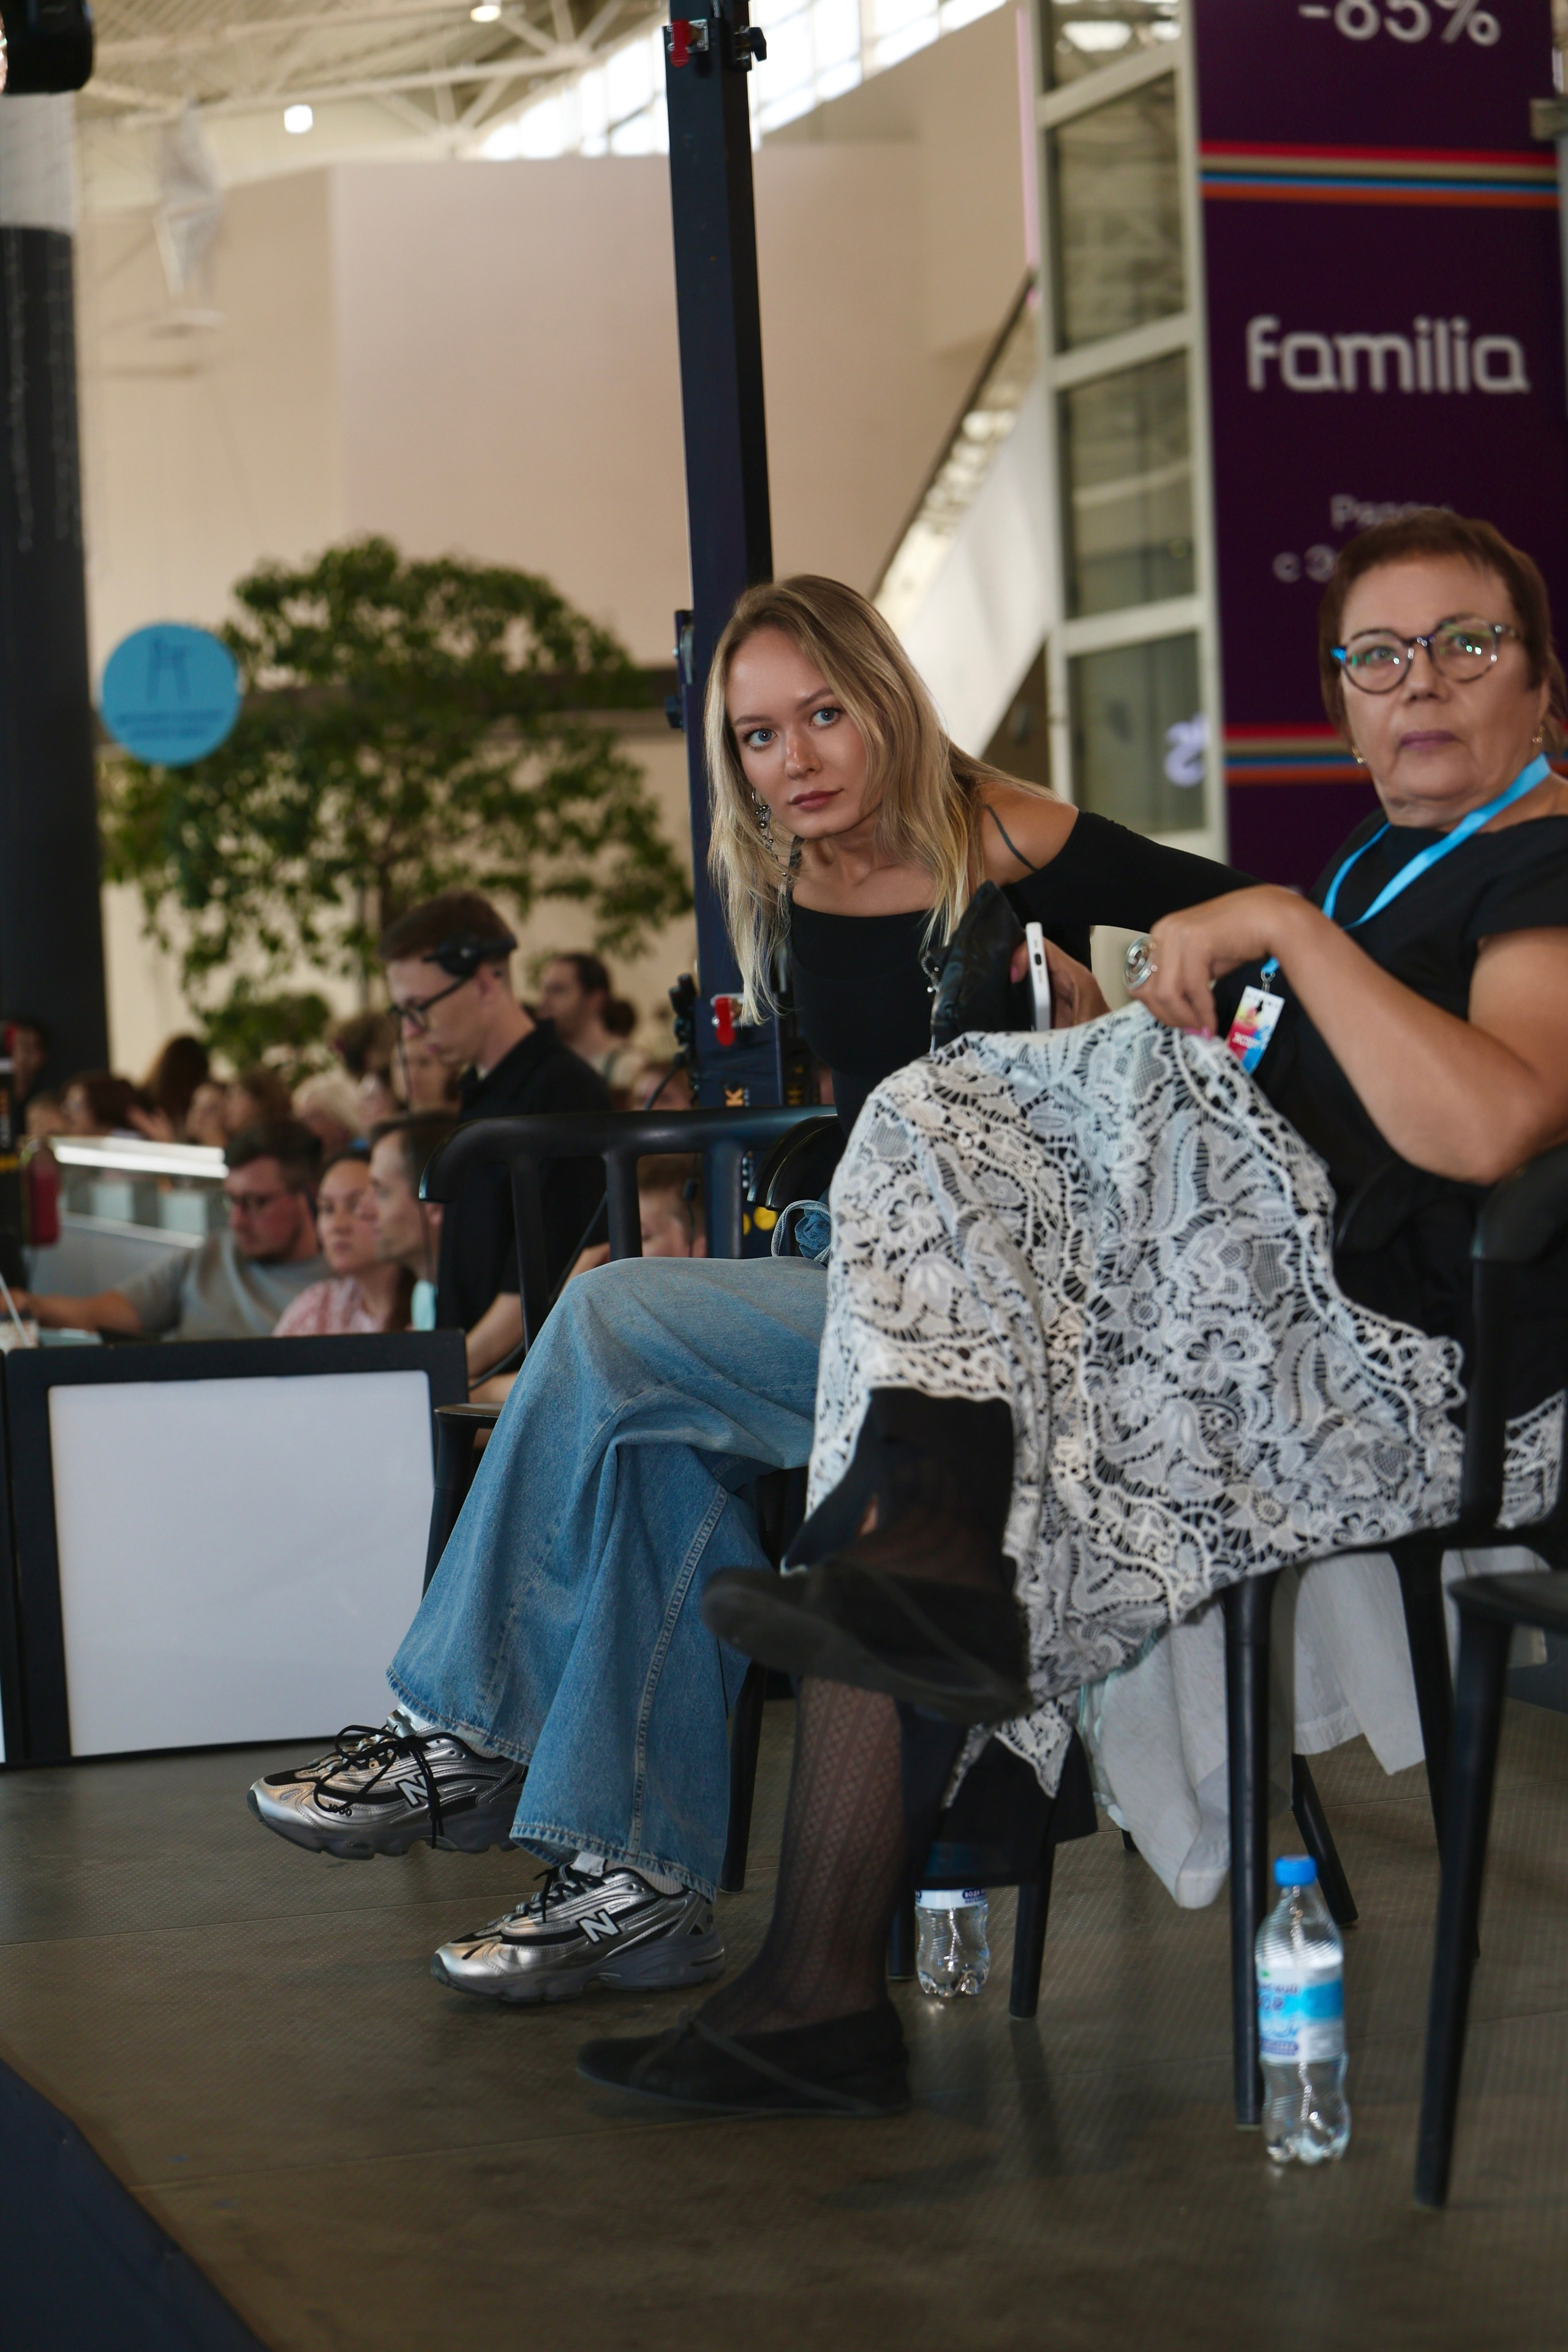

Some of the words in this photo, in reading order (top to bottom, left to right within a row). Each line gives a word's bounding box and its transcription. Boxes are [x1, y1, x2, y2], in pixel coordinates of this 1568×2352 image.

[1245, 314, 1531, 394] familia
[395, 1772, 429, 1807] N
[576, 1908, 623, 1945] N
